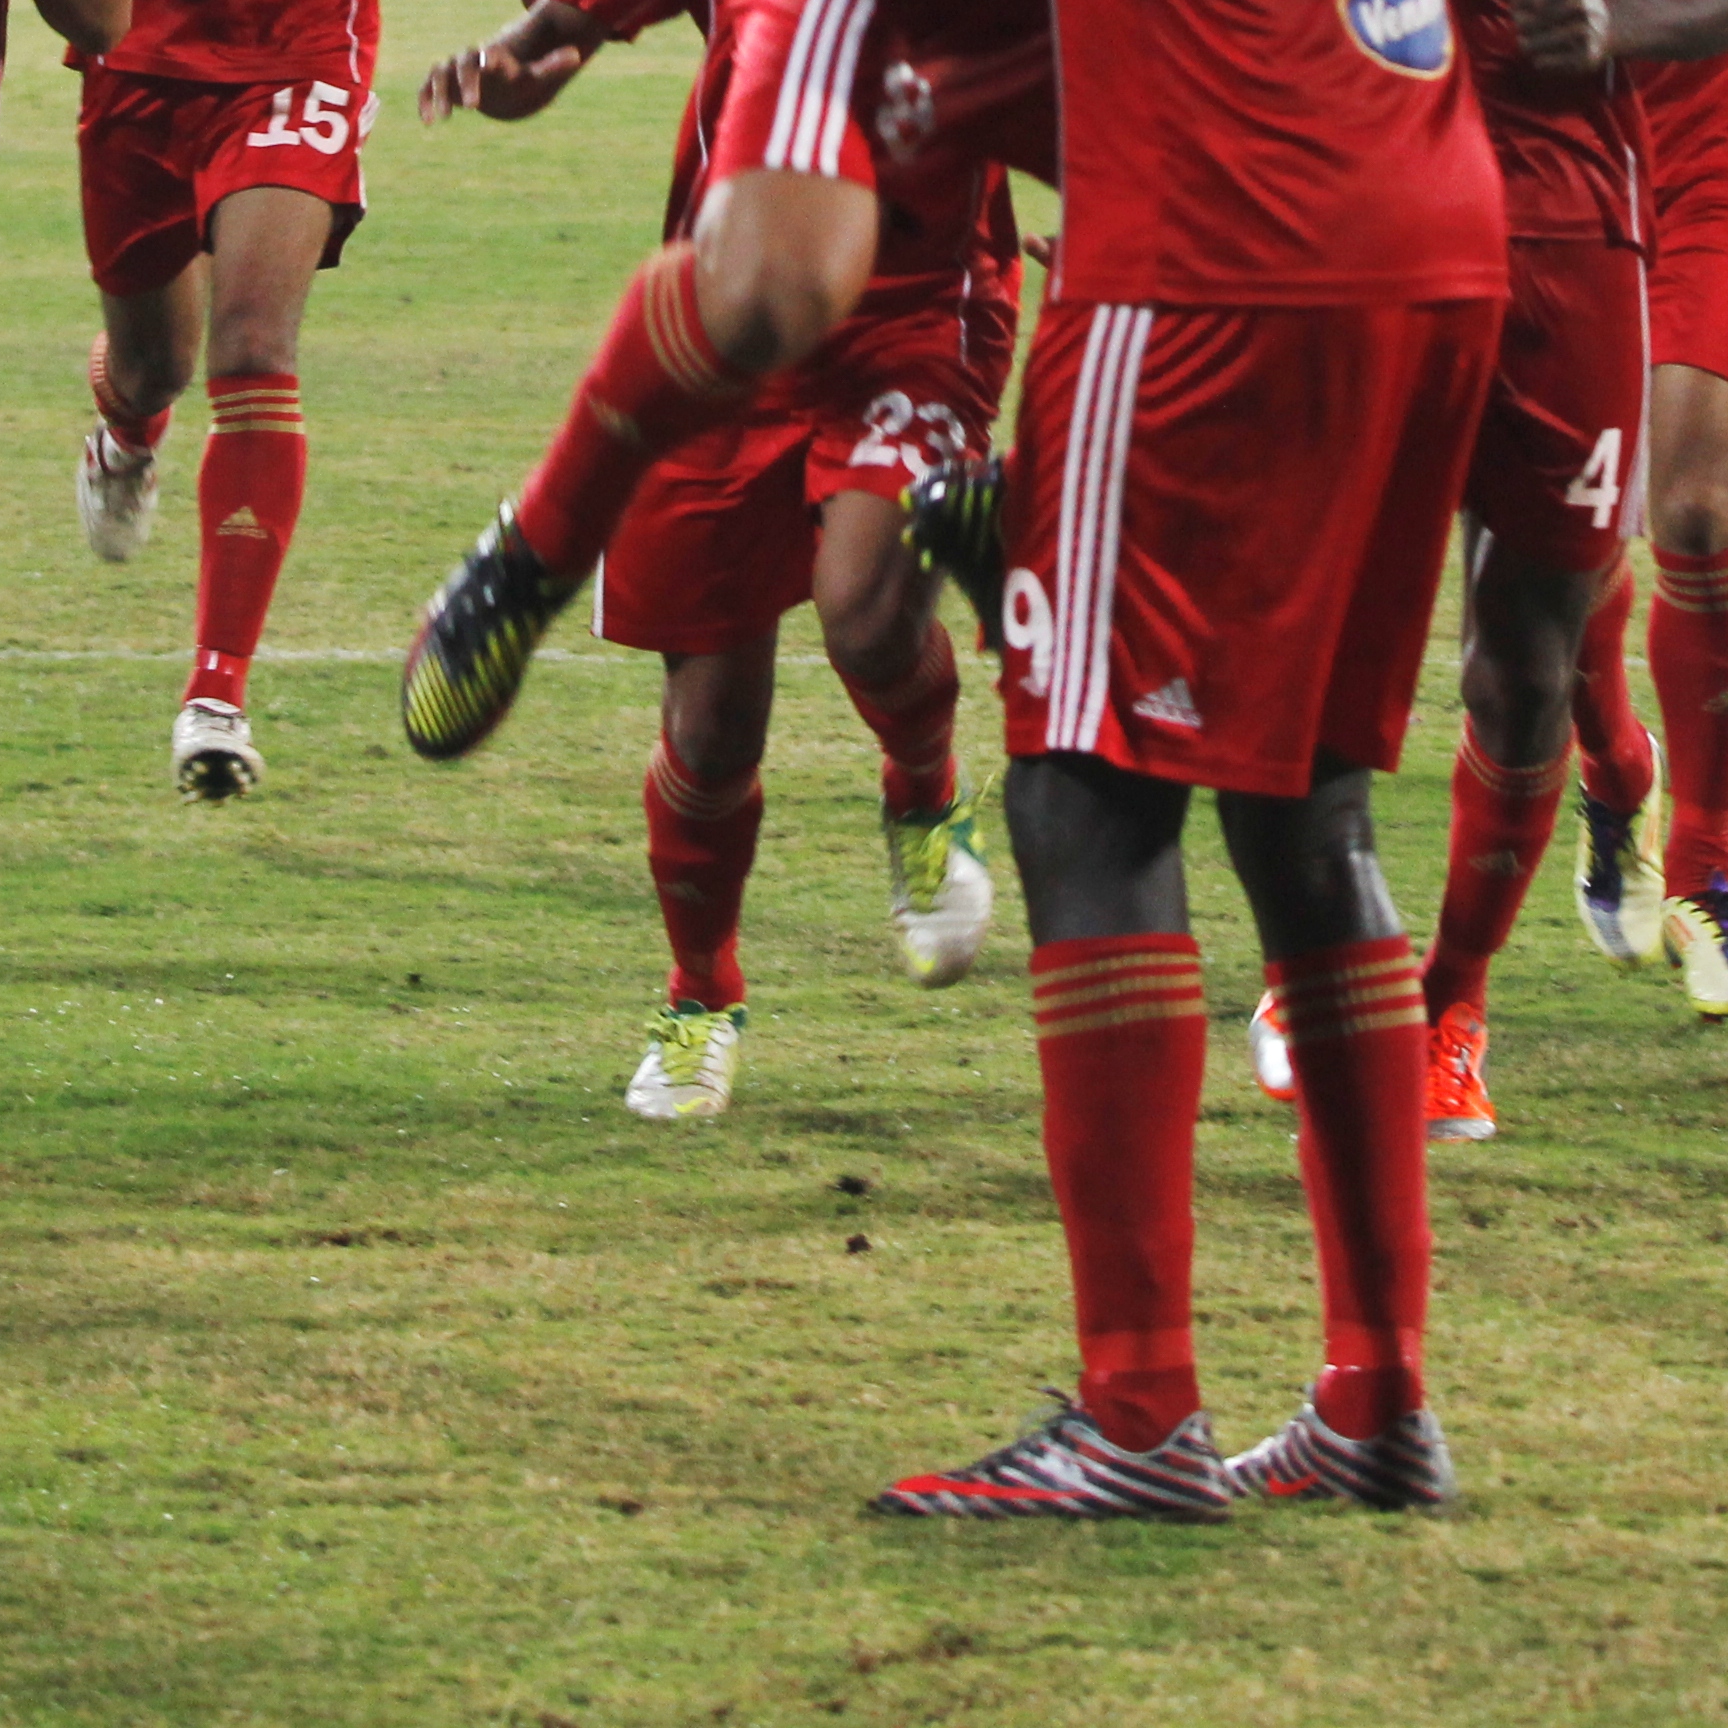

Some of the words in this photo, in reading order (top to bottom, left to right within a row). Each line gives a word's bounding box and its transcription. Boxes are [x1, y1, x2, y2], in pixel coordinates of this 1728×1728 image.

[246, 79, 351, 155] 15
[847, 389, 967, 486] 23
[1564, 426, 1623, 529] 4
[1002, 566, 1053, 698] 9
